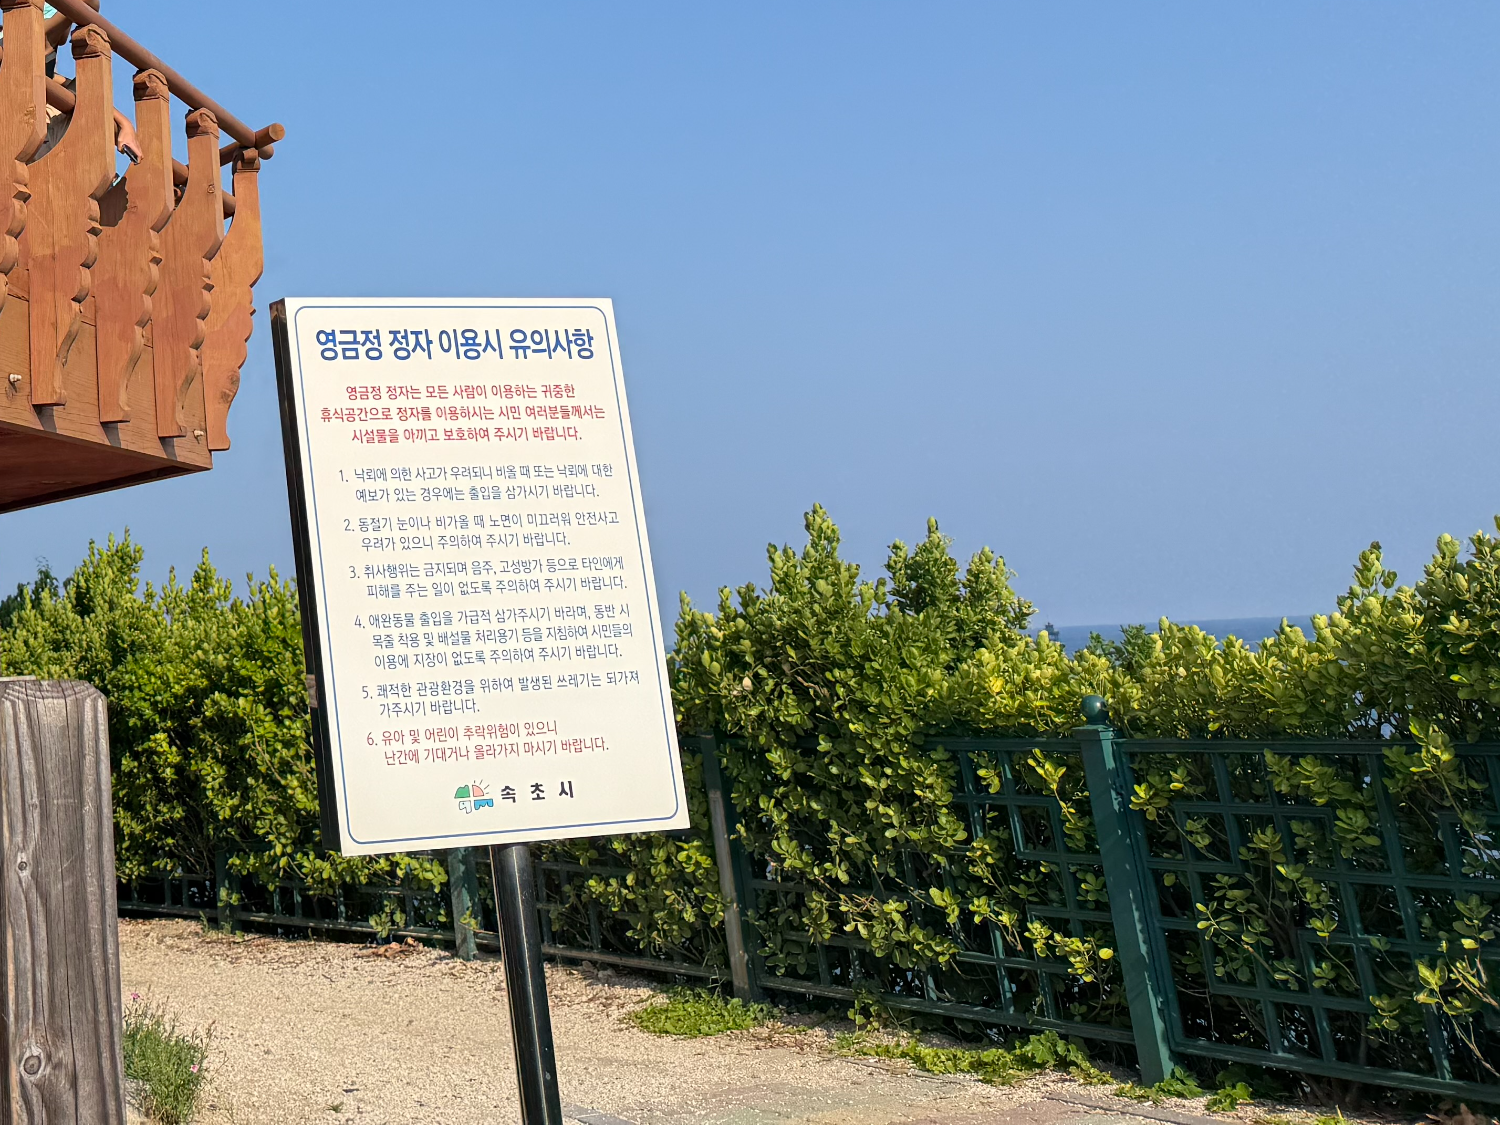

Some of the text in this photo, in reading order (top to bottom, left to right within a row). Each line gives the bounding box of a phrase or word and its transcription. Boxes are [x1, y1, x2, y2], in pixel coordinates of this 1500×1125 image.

[315, 328, 594, 361] 영금정 정자 이용시 유의사항
[346, 383, 575, 401] 영금정 정자는 모든 사람이 이용하는 귀중한
[320, 405, 605, 423] 휴식공간으로 정자를 이용하시는 시민 여러분들께서는
[352, 426, 582, 444] 시설물을 아끼고 보호하여 주시기 바랍니다.
[339, 463, 613, 482] 1. 낙뢰에 의한 사고가 우려되니 비올 때 또는 낙뢰에 대한
[355, 484, 599, 503] 예보가 있는 경우에는 출입을 삼가시기 바랍니다.
[343, 511, 619, 533] 2. 동절기 눈이나 비가올 때 노면이 미끄러워 안전사고
[361, 531, 570, 552] 우려가 있으니 주의하여 주시기 바랍니다.
[348, 556, 624, 579] 3. 취사행위는 금지되며 음주, 고성방가 등으로 타인에게
[366, 575, 627, 599] 피해를 주는 일이 없도록 주의하여 주시기 바랍니다.
[354, 603, 630, 629] 4. 애완동물 출입을 가급적 삼가주시기 바라며, 동반 시
[372, 634, 394, 649] 목줄
[398, 632, 420, 648] 착용
[423, 632, 435, 647] 및
[437, 630, 471, 646] 배설물
[475, 628, 519, 645] 처리용기
[521, 627, 543, 643] 등을
[591, 623, 633, 639] 시민들의
[374, 643, 623, 670] 이용에 지장이 없도록 주의하여 주시기 바랍니다.
[362, 670, 640, 699] 5. 쾌적한 관광환경을 위하여 발생된 쓰레기는 되가져
[380, 698, 480, 718] 가주시기 바랍니다.
[367, 720, 558, 746] 6. 유아 및 어린이 추락위험이 있으니
[384, 737, 609, 766] 난간에 기대거나 올라가지 마시기 바랍니다.
